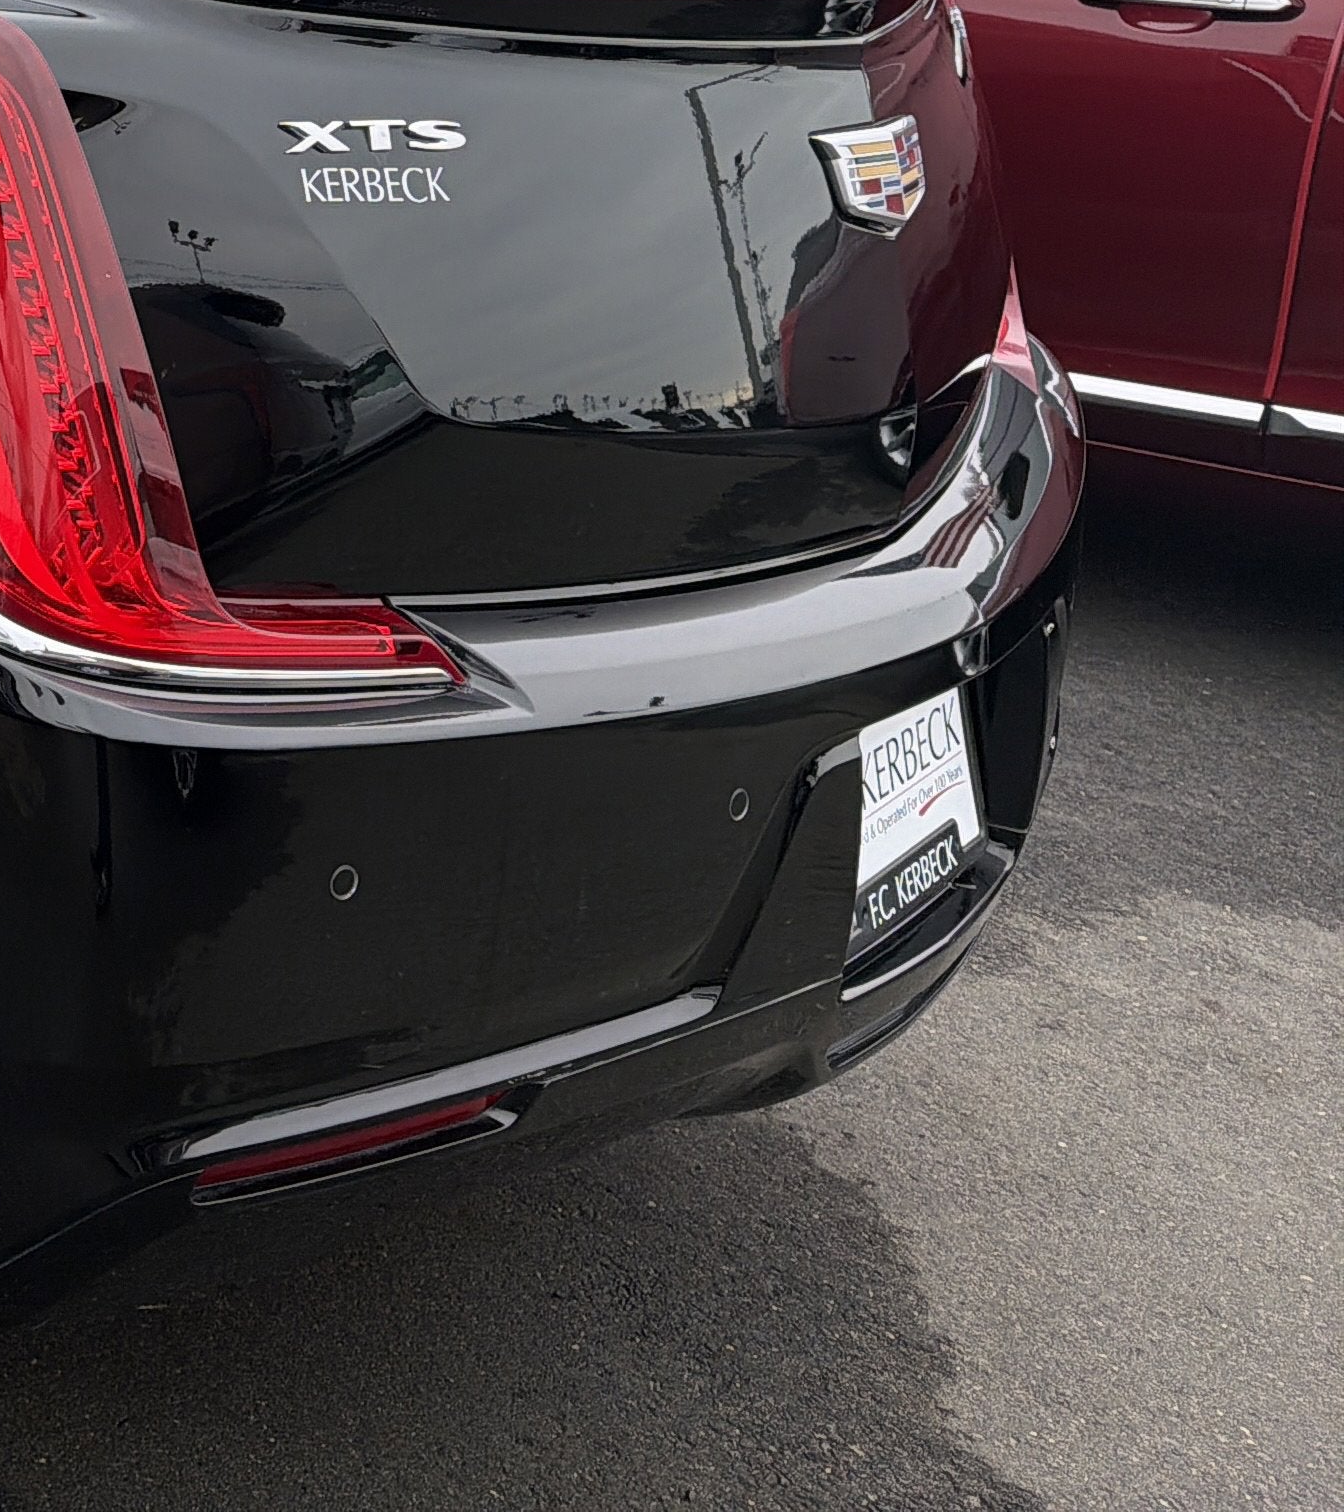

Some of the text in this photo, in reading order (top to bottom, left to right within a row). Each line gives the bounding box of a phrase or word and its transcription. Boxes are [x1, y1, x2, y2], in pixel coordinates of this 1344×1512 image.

[277, 119, 467, 154] XTS
[300, 166, 451, 203] KERBECK
[861, 695, 961, 810] KERBECK
[876, 799, 907, 835] Operated
[907, 796, 918, 814] For
[918, 785, 934, 805] Over
[868, 835, 959, 929] F.C. KERBECK
